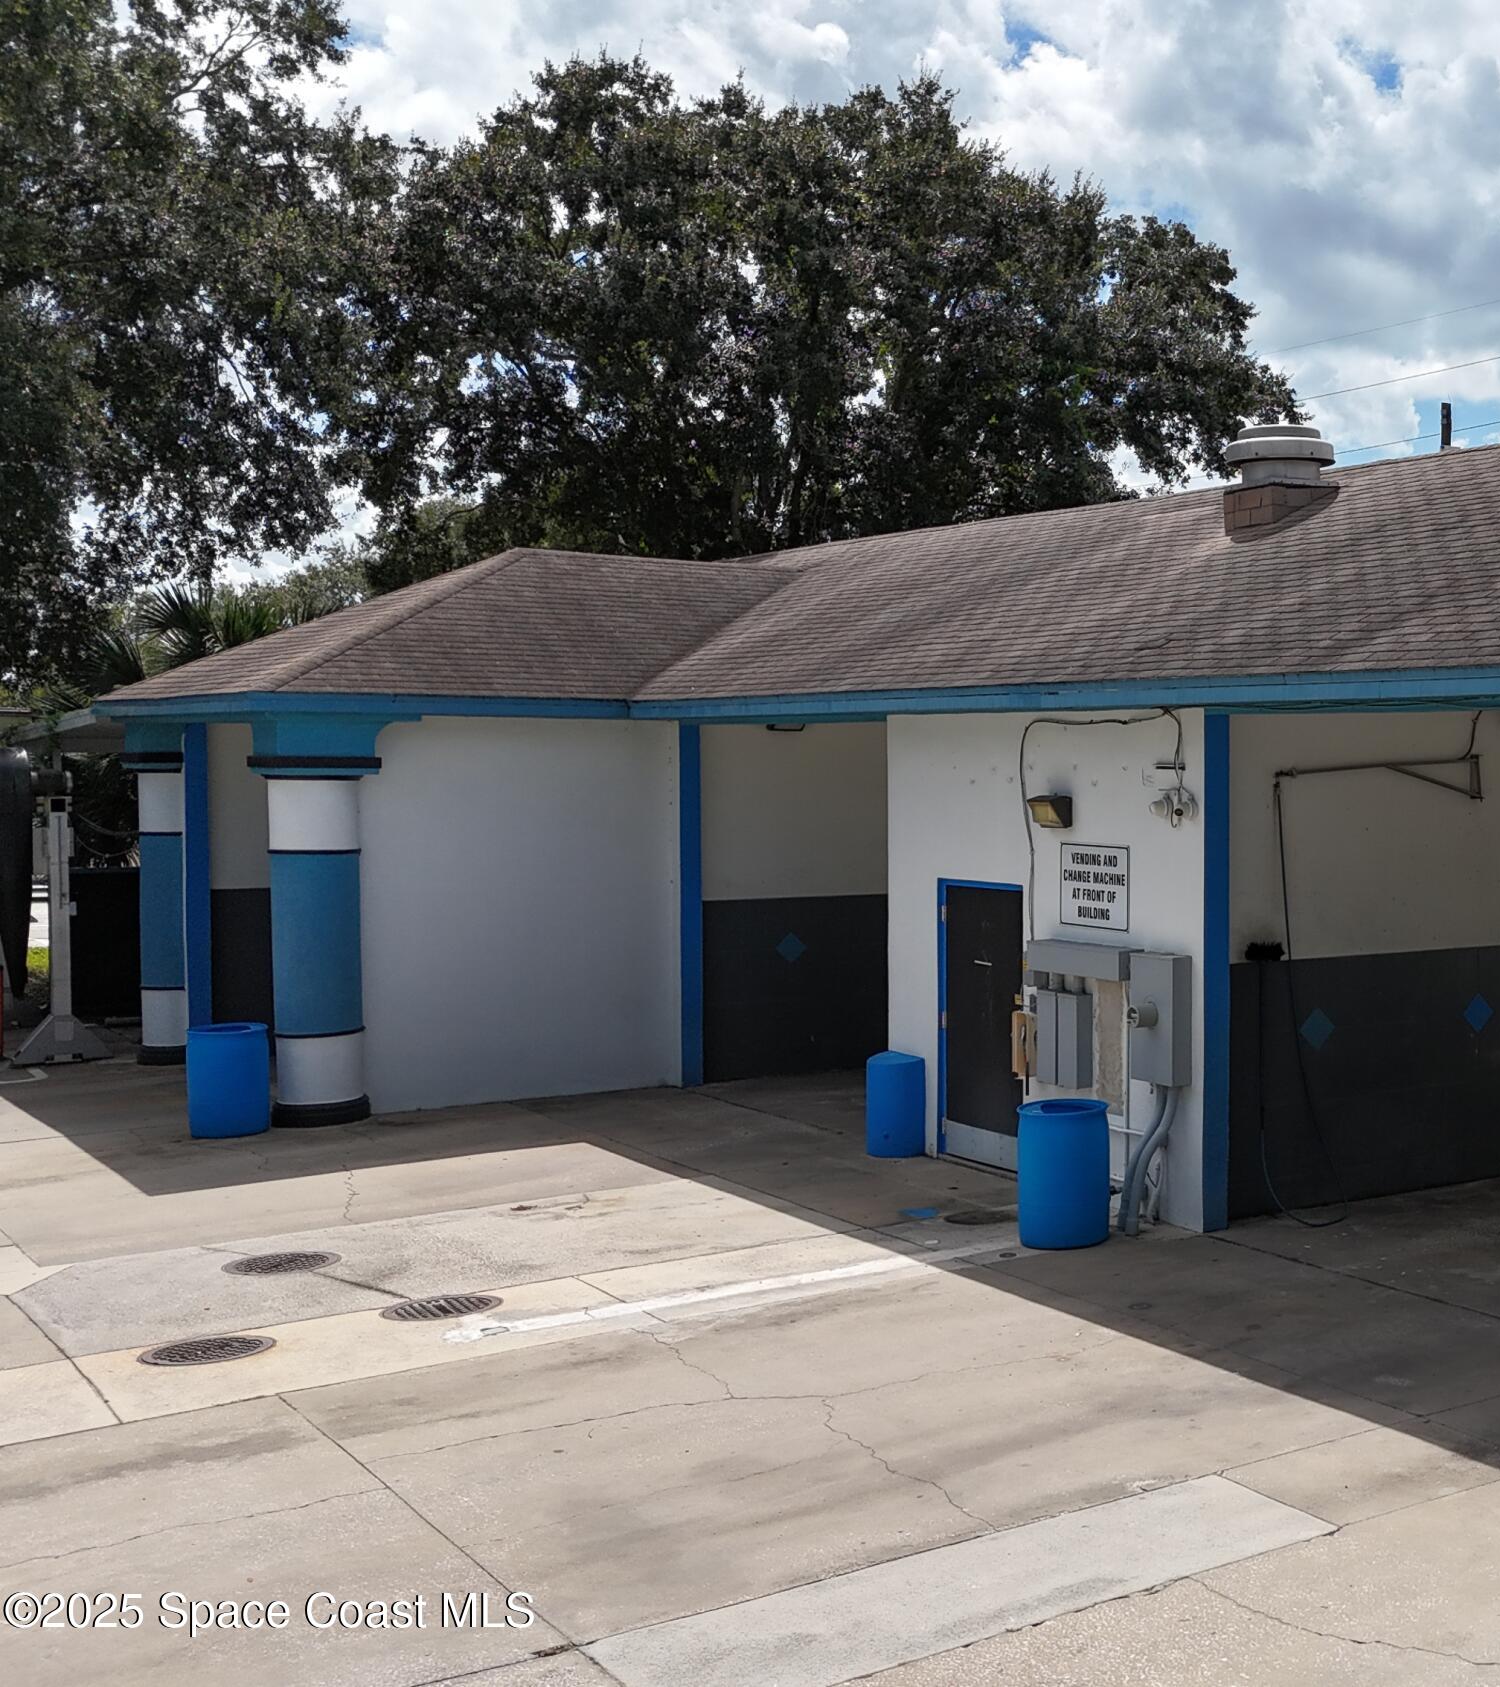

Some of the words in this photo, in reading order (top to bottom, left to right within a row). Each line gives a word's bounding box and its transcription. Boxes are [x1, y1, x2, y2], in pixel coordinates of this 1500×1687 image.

[1071, 852, 1101, 866] VENDING
[1103, 855, 1117, 867] AND
[1063, 869, 1091, 883] CHANGE
[1093, 872, 1125, 886] MACHINE
[1072, 887, 1080, 900] AT
[1082, 888, 1105, 902] FRONT
[1107, 890, 1116, 903] OF
[1078, 906, 1110, 920] BUILDING
